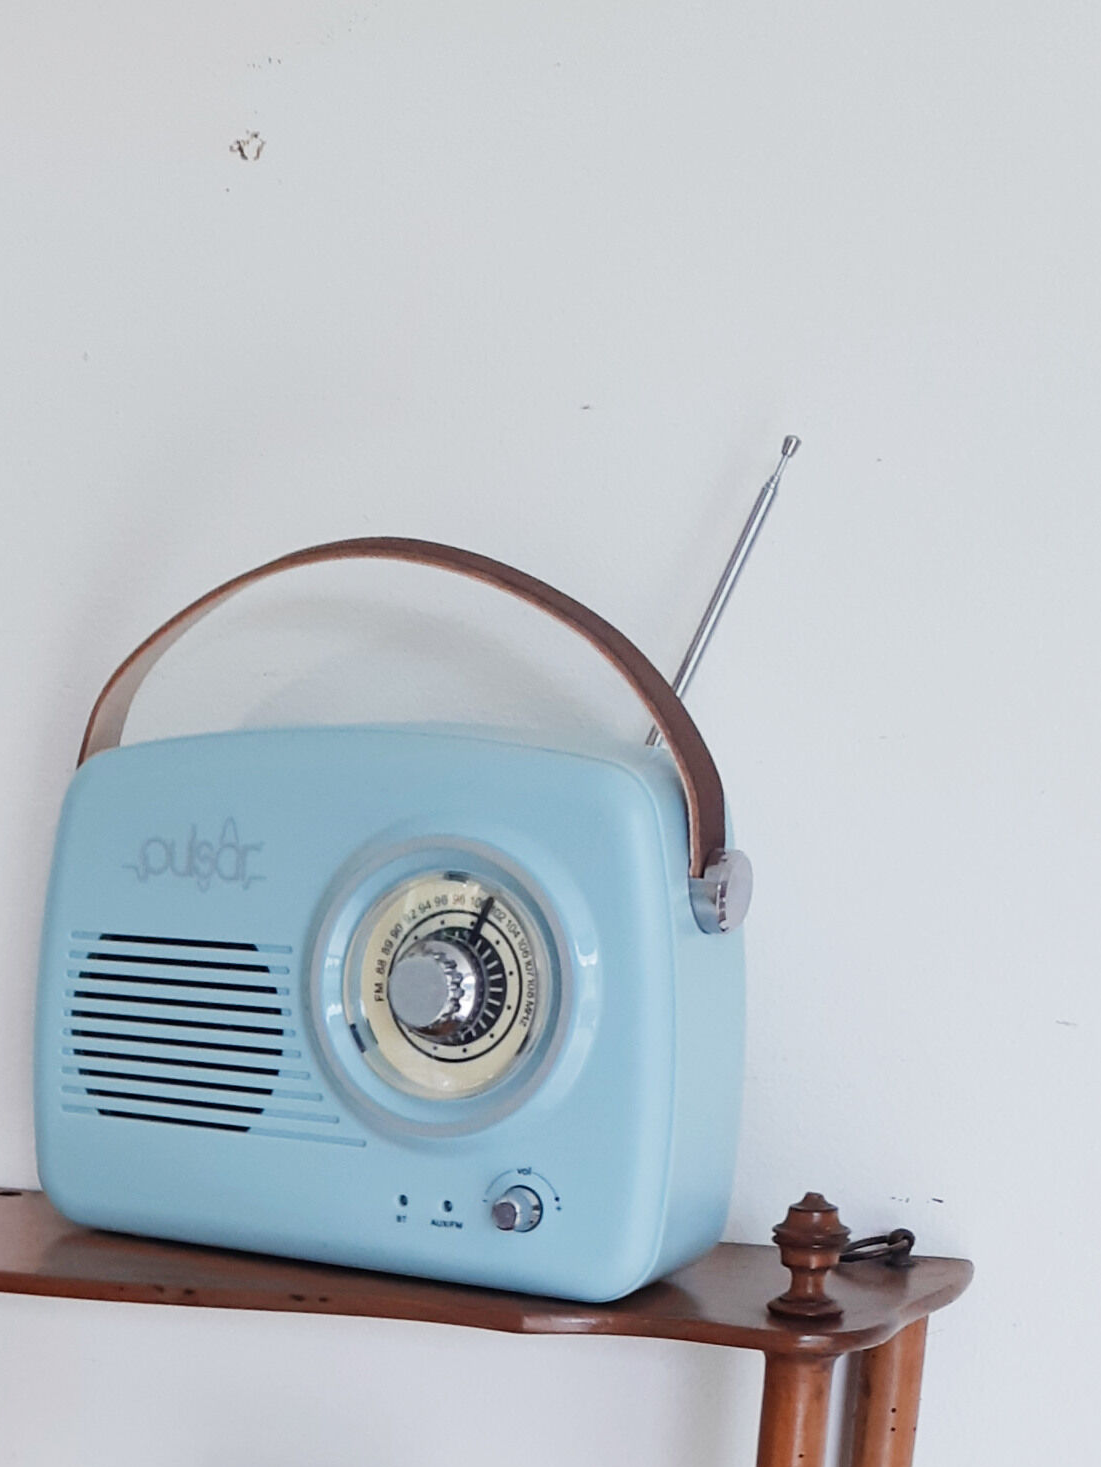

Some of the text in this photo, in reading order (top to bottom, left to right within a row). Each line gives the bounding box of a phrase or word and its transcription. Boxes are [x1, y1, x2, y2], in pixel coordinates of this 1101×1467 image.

[373, 982, 386, 1003] FM
[418, 898, 433, 914] 94
[505, 918, 522, 939] 104
[516, 1166, 533, 1177] vol
